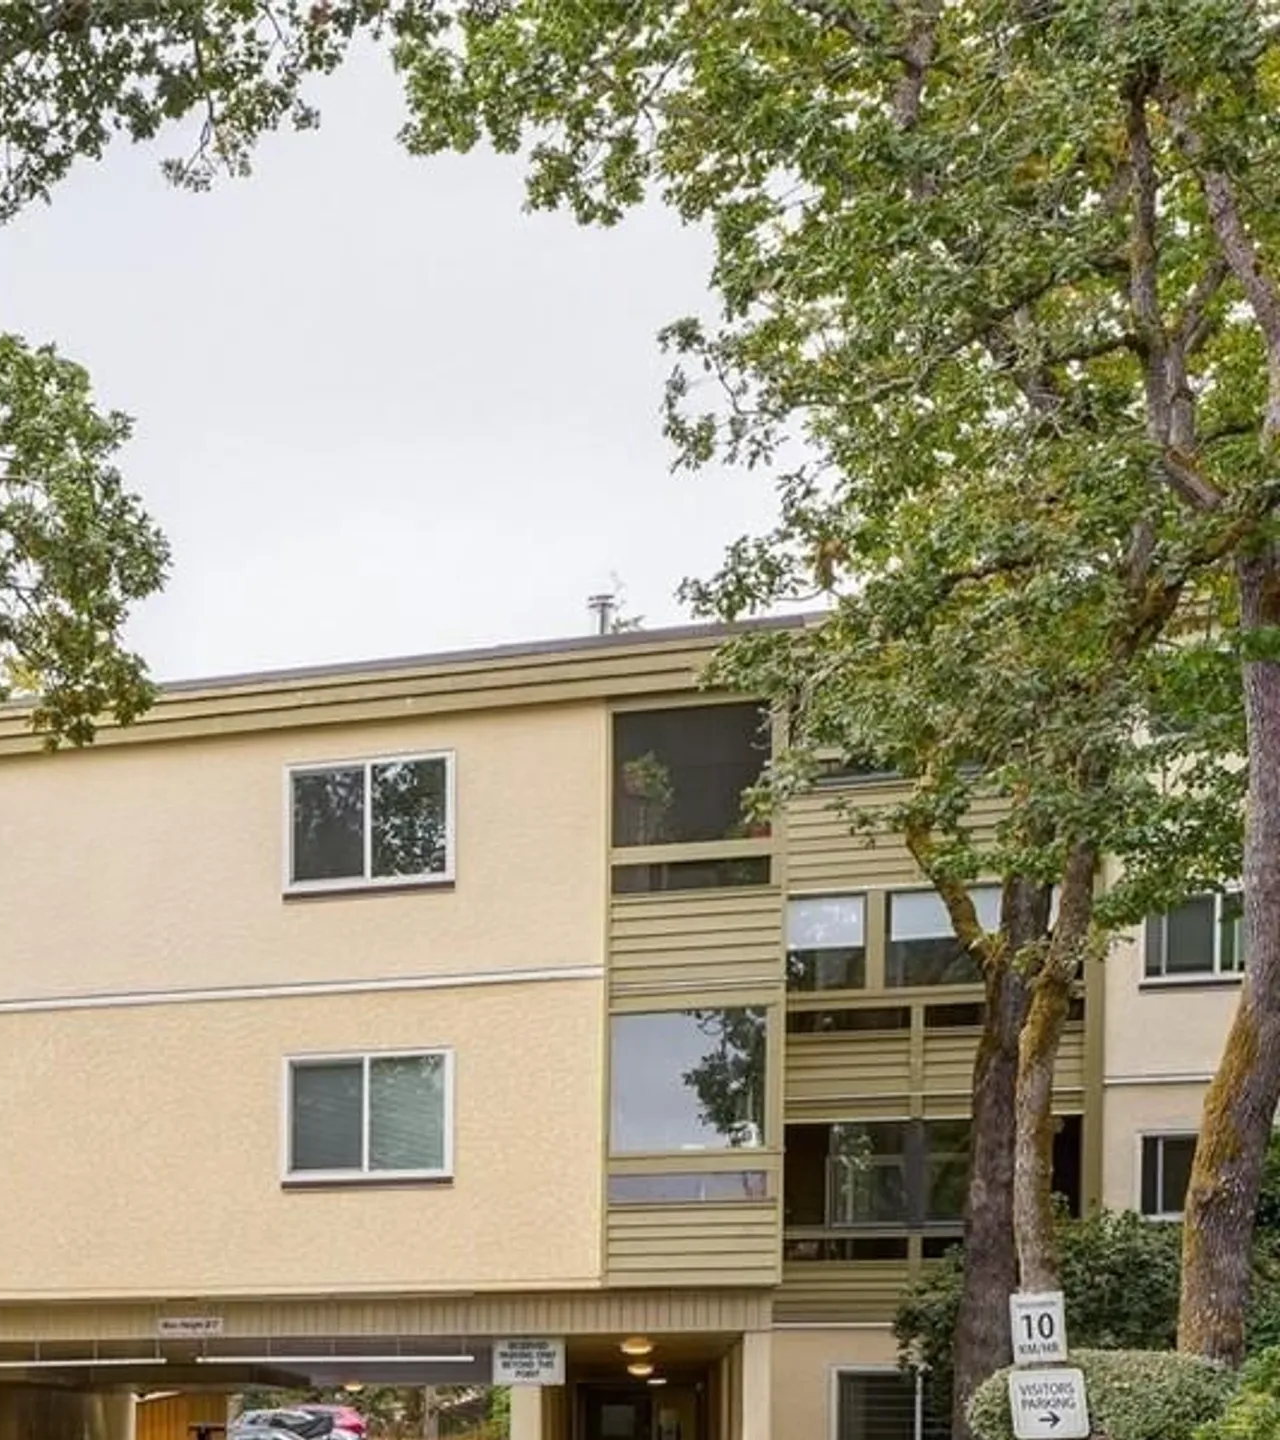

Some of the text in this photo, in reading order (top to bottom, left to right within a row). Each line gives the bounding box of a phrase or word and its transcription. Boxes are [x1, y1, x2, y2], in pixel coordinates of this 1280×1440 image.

[1020, 1312, 1055, 1341] 10
[1018, 1382, 1076, 1396] VISITORS
[1020, 1397, 1078, 1411] PARKING
